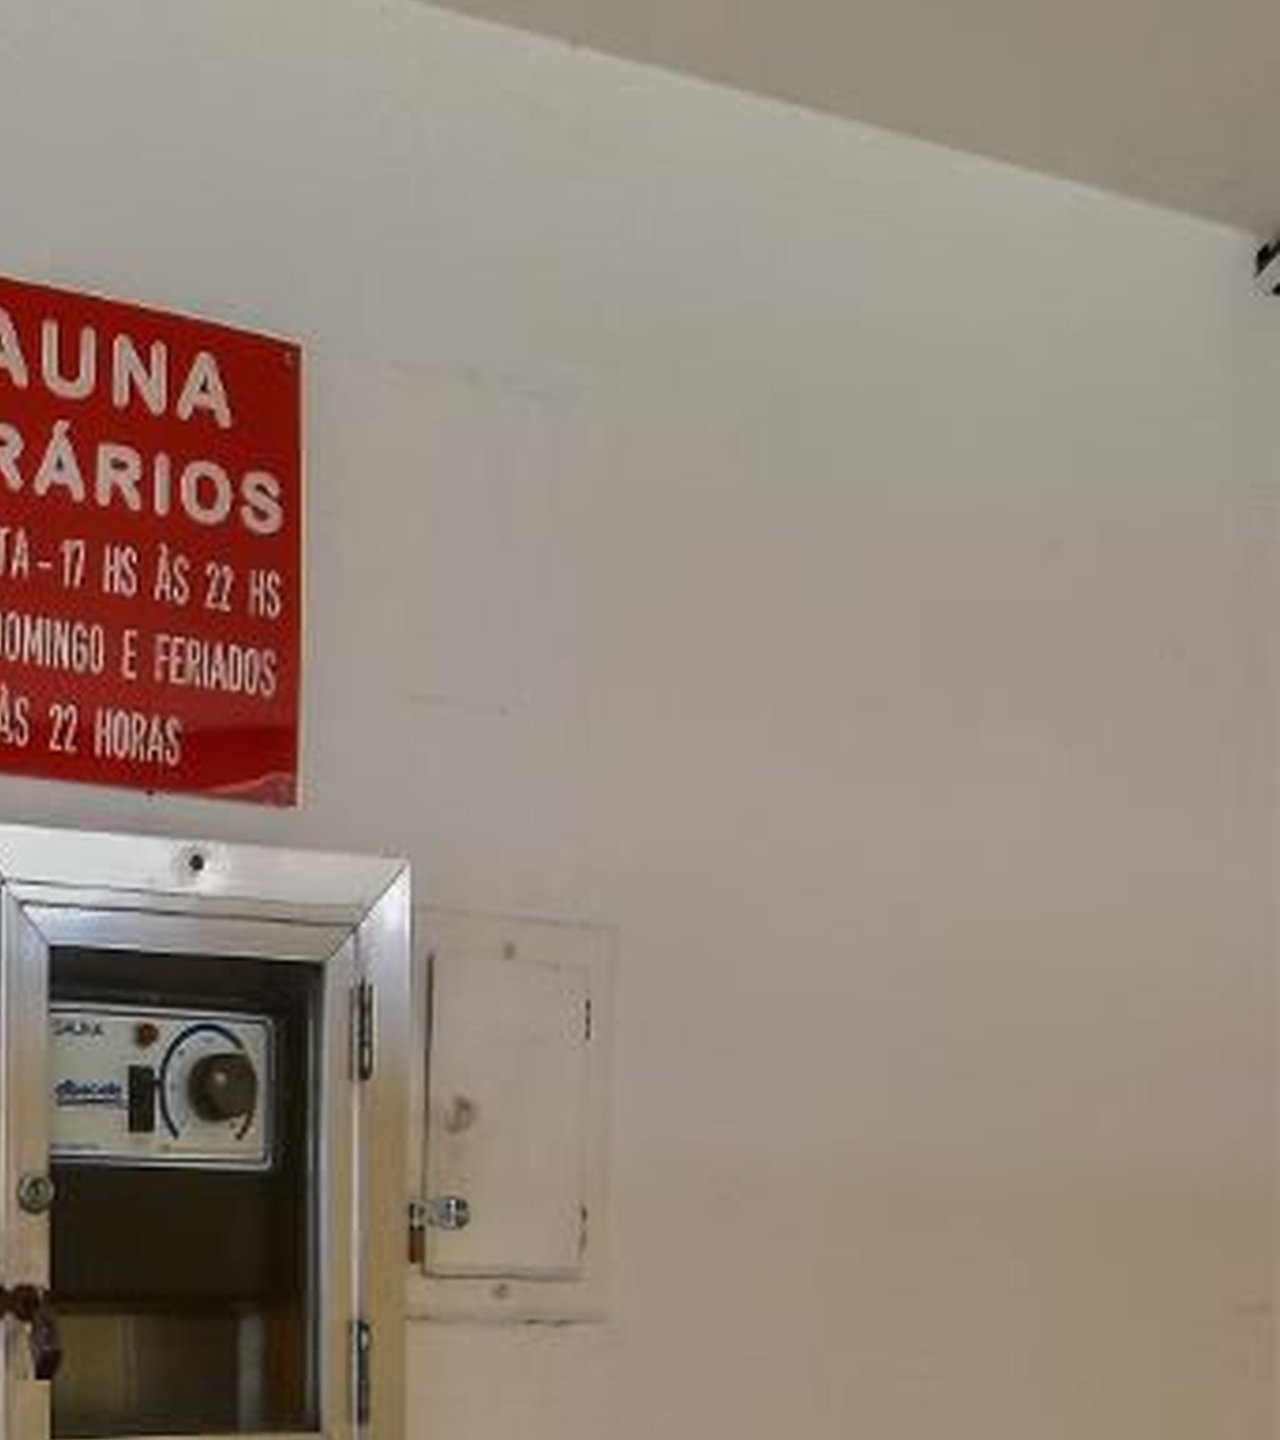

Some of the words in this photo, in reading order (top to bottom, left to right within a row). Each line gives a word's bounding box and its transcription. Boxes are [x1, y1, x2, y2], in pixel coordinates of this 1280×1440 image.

[103, 544, 138, 598] HS
[205, 561, 235, 613] 22
[249, 569, 283, 619] HS
[121, 629, 138, 680] E
[154, 633, 278, 698] FERIADOS
[48, 703, 78, 753] 22
[94, 706, 184, 767] HORAS
